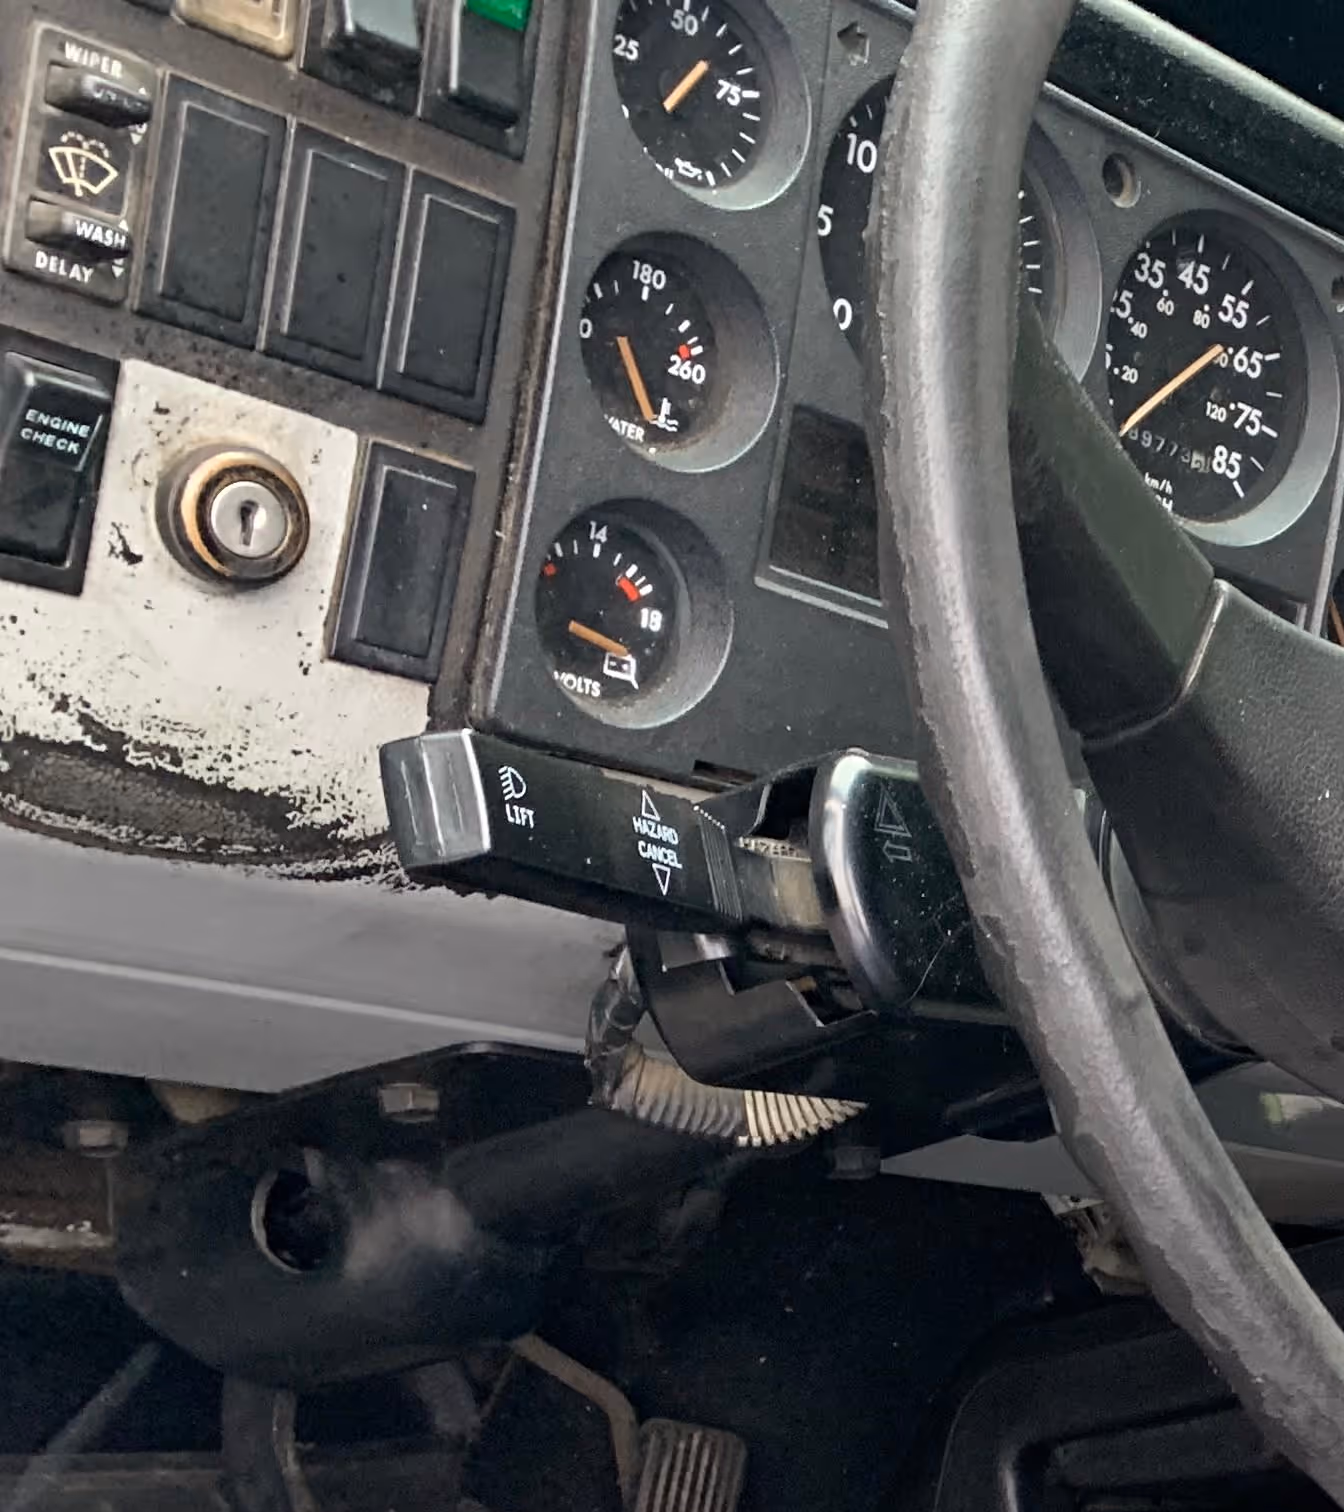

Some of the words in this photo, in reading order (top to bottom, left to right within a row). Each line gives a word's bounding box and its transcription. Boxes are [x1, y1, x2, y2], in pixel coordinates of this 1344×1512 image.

[670, 8, 699, 36] 50
[63, 40, 124, 79] WIPER
[613, 34, 640, 61] 25
[716, 79, 742, 106] 75
[846, 132, 878, 174] 10
[75, 219, 127, 249] WASH
[817, 203, 834, 237] 5
[34, 249, 95, 286] DELAY
[632, 259, 666, 290] 180
[1134, 252, 1167, 289] 35
[1177, 260, 1212, 295] 45
[833, 297, 853, 331] 0
[1156, 299, 1175, 316] 60
[1193, 309, 1211, 329] 80
[1217, 293, 1250, 329] 55
[579, 317, 593, 339] 0
[1130, 321, 1148, 339] 40
[667, 353, 706, 385] 260
[1121, 364, 1139, 384] 20
[1232, 345, 1263, 379] 65
[25, 407, 91, 438] ENGINE
[1205, 401, 1228, 422] 120
[1233, 402, 1264, 436] 75
[20, 427, 81, 455] CHECK
[604, 413, 645, 443] ATER
[1211, 444, 1243, 480] 85
[589, 520, 609, 544] 14
[640, 607, 663, 633] 18
[504, 802, 535, 829] LIFT
[631, 815, 680, 846] HAZARD
[637, 840, 684, 870] CANCEL
